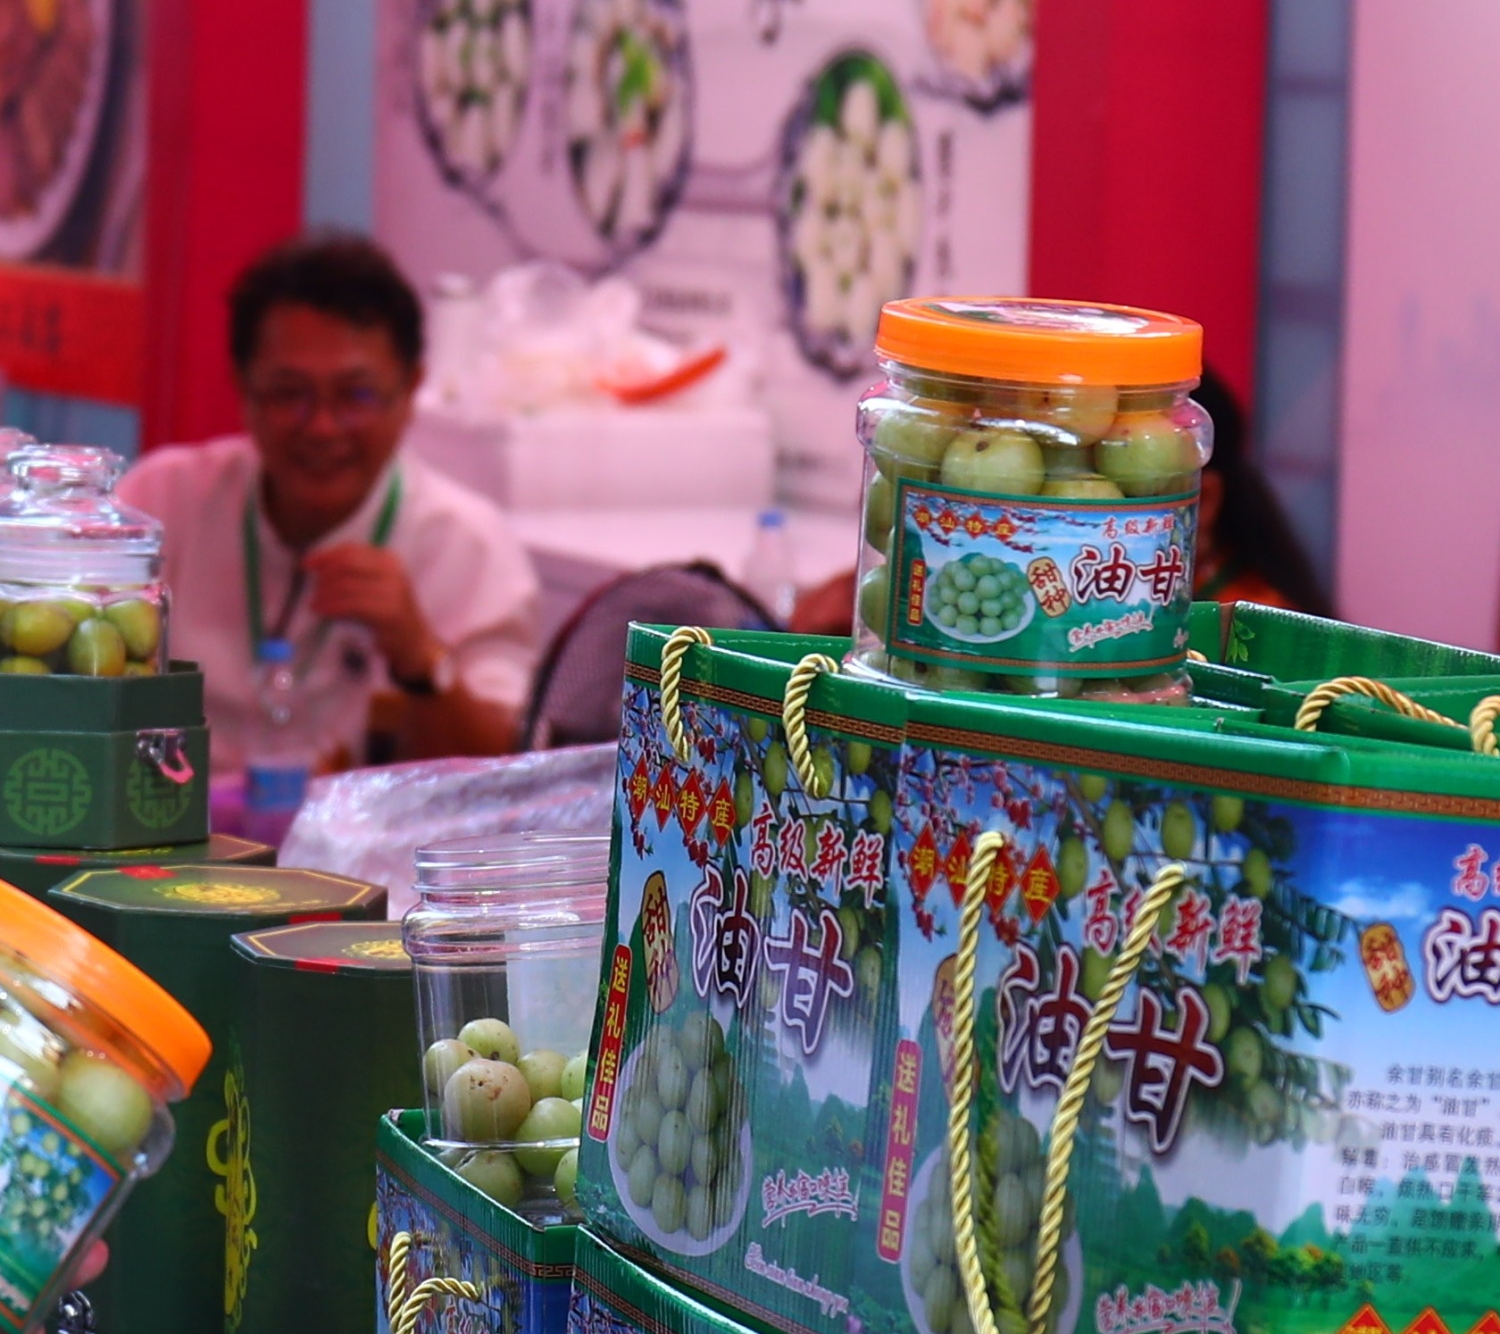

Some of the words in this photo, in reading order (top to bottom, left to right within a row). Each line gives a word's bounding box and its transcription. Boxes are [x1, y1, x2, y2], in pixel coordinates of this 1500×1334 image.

[1070, 541, 1185, 606] 油甘
[751, 803, 884, 910] 高级新鲜
[591, 955, 629, 1133] 送礼佳品
[691, 864, 854, 1055] 油甘
[999, 941, 1225, 1153] 油甘
